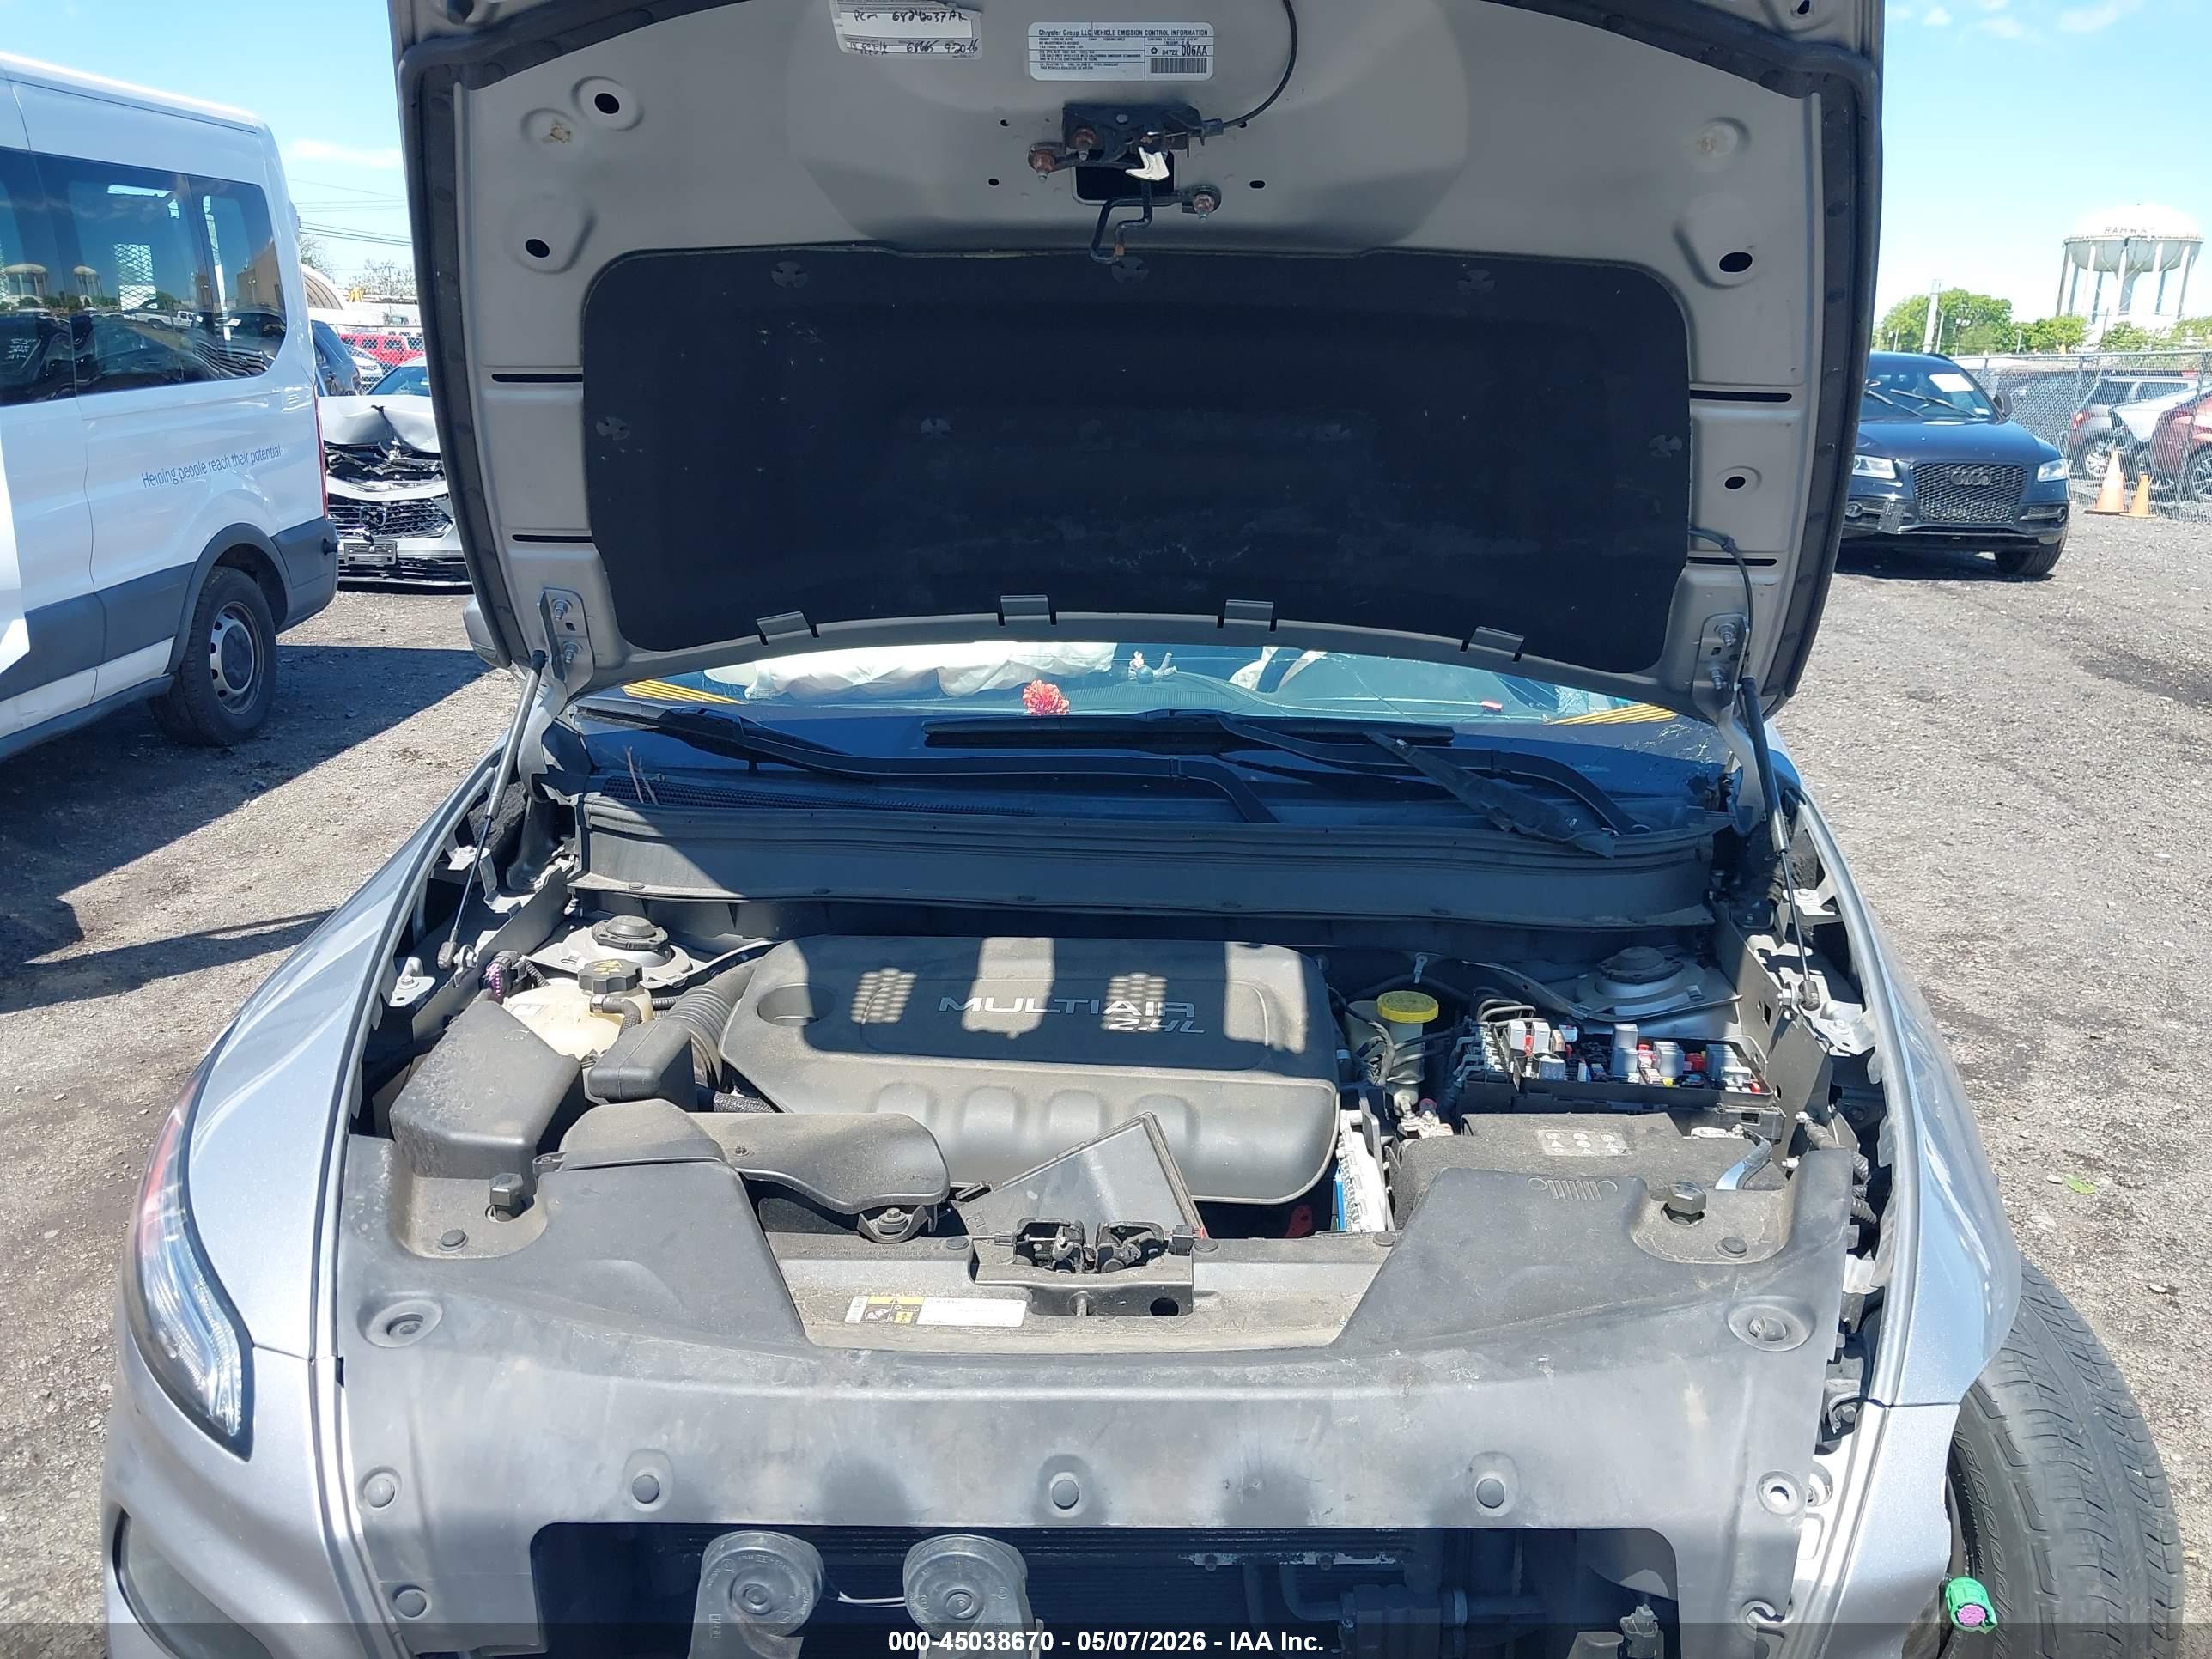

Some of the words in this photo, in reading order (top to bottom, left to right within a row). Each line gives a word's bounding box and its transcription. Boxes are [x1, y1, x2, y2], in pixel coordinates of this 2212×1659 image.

[1181, 46, 1208, 56] 006AA
[141, 468, 179, 489] Helping
[179, 460, 208, 481] people
[208, 454, 231, 472] reach
[231, 452, 249, 468] their
[250, 443, 282, 465] potential
[939, 997, 1195, 1018] MULTIAIR
[1107, 1017, 1206, 1034] 2.4L
